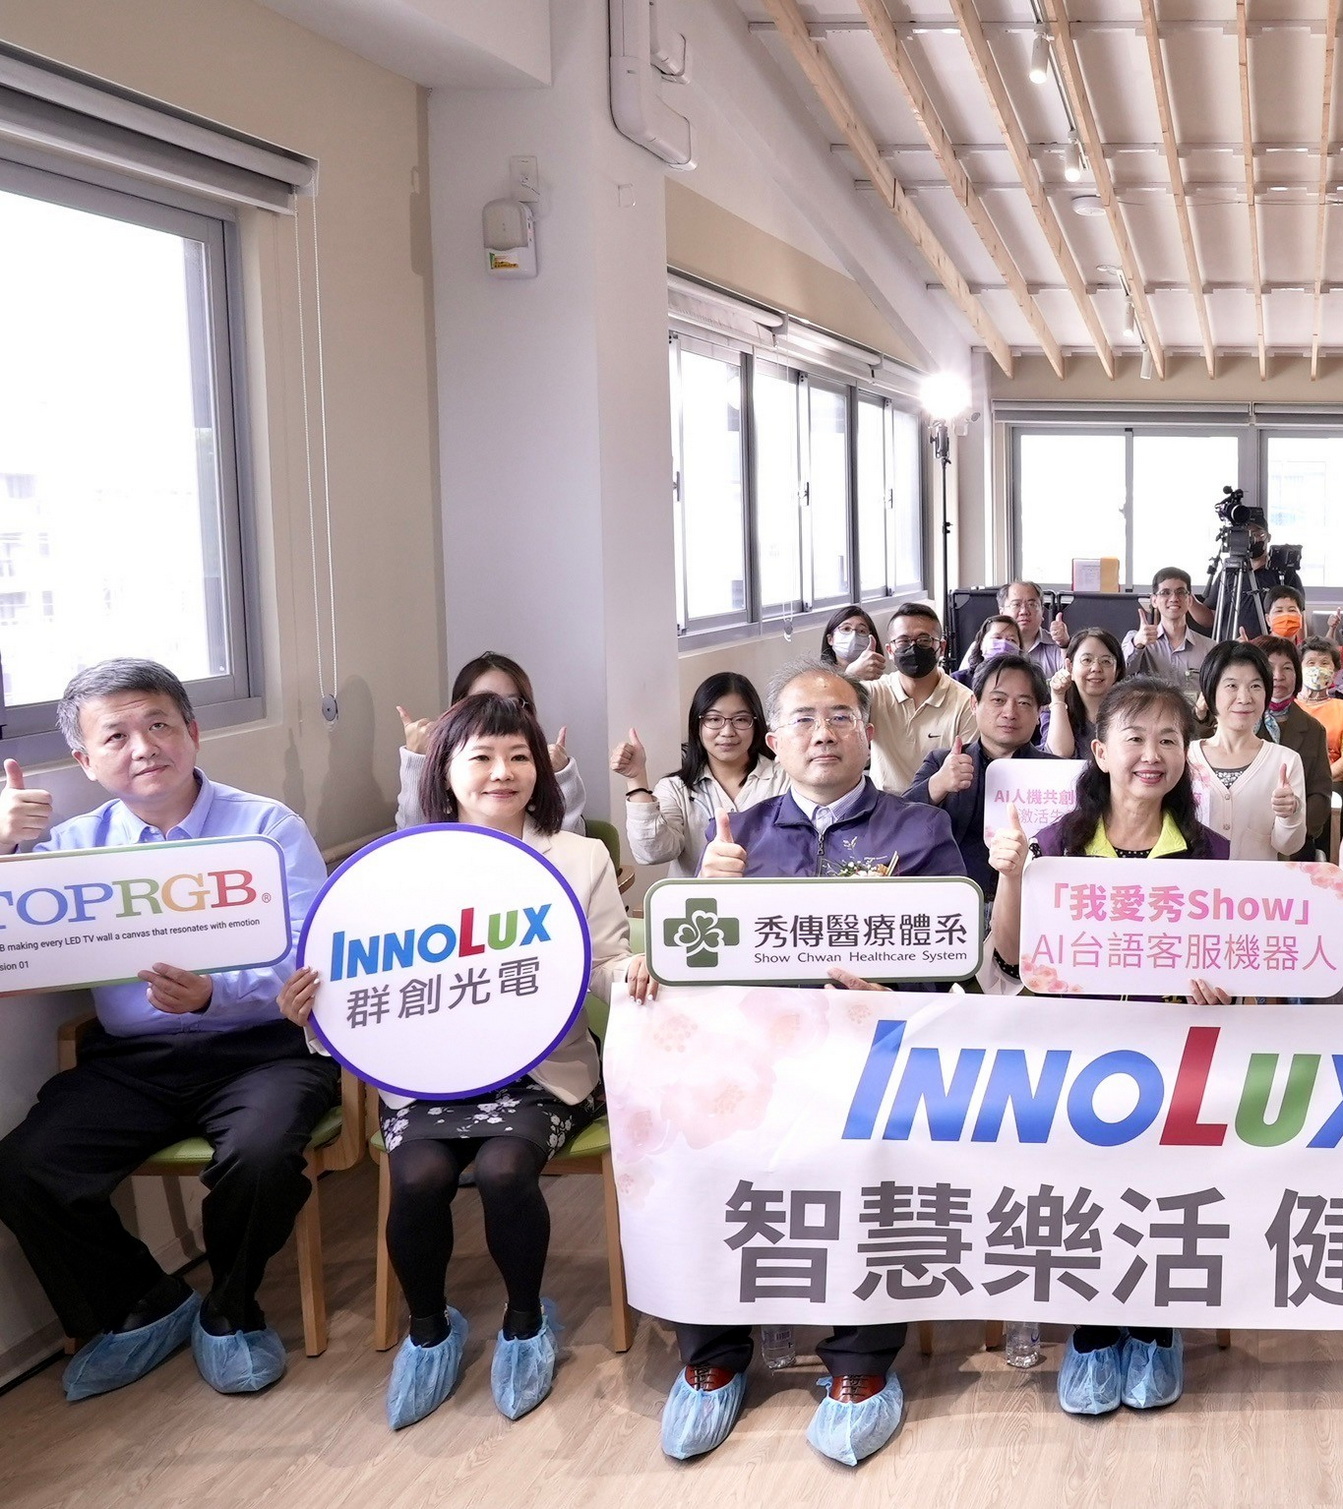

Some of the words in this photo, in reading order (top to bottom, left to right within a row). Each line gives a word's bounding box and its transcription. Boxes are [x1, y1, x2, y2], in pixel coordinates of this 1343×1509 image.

[993, 788, 1076, 806] AI人機共創
[1054, 882, 1310, 926] 「我愛秀Show」
[7, 941, 39, 951] making
[40, 939, 63, 948] every
[64, 936, 81, 945] LED
[82, 935, 94, 943] TV
[96, 932, 113, 942] wall
[122, 930, 151, 940] canvas
[152, 927, 169, 936] that
[169, 924, 209, 934] resonates
[210, 921, 227, 930] with
[228, 918, 261, 928] emotion
[753, 912, 968, 949] 秀傳醫療體系
[18, 961, 29, 969] 01
[753, 952, 791, 964] Show
[797, 951, 842, 963] Chwan
[849, 950, 916, 962] Healthcare
[921, 950, 968, 962] System
[1030, 931, 1338, 972] AI台語客服機器人
[346, 956, 540, 1029] 群創光電
[724, 1179, 1231, 1308] 智慧樂活
